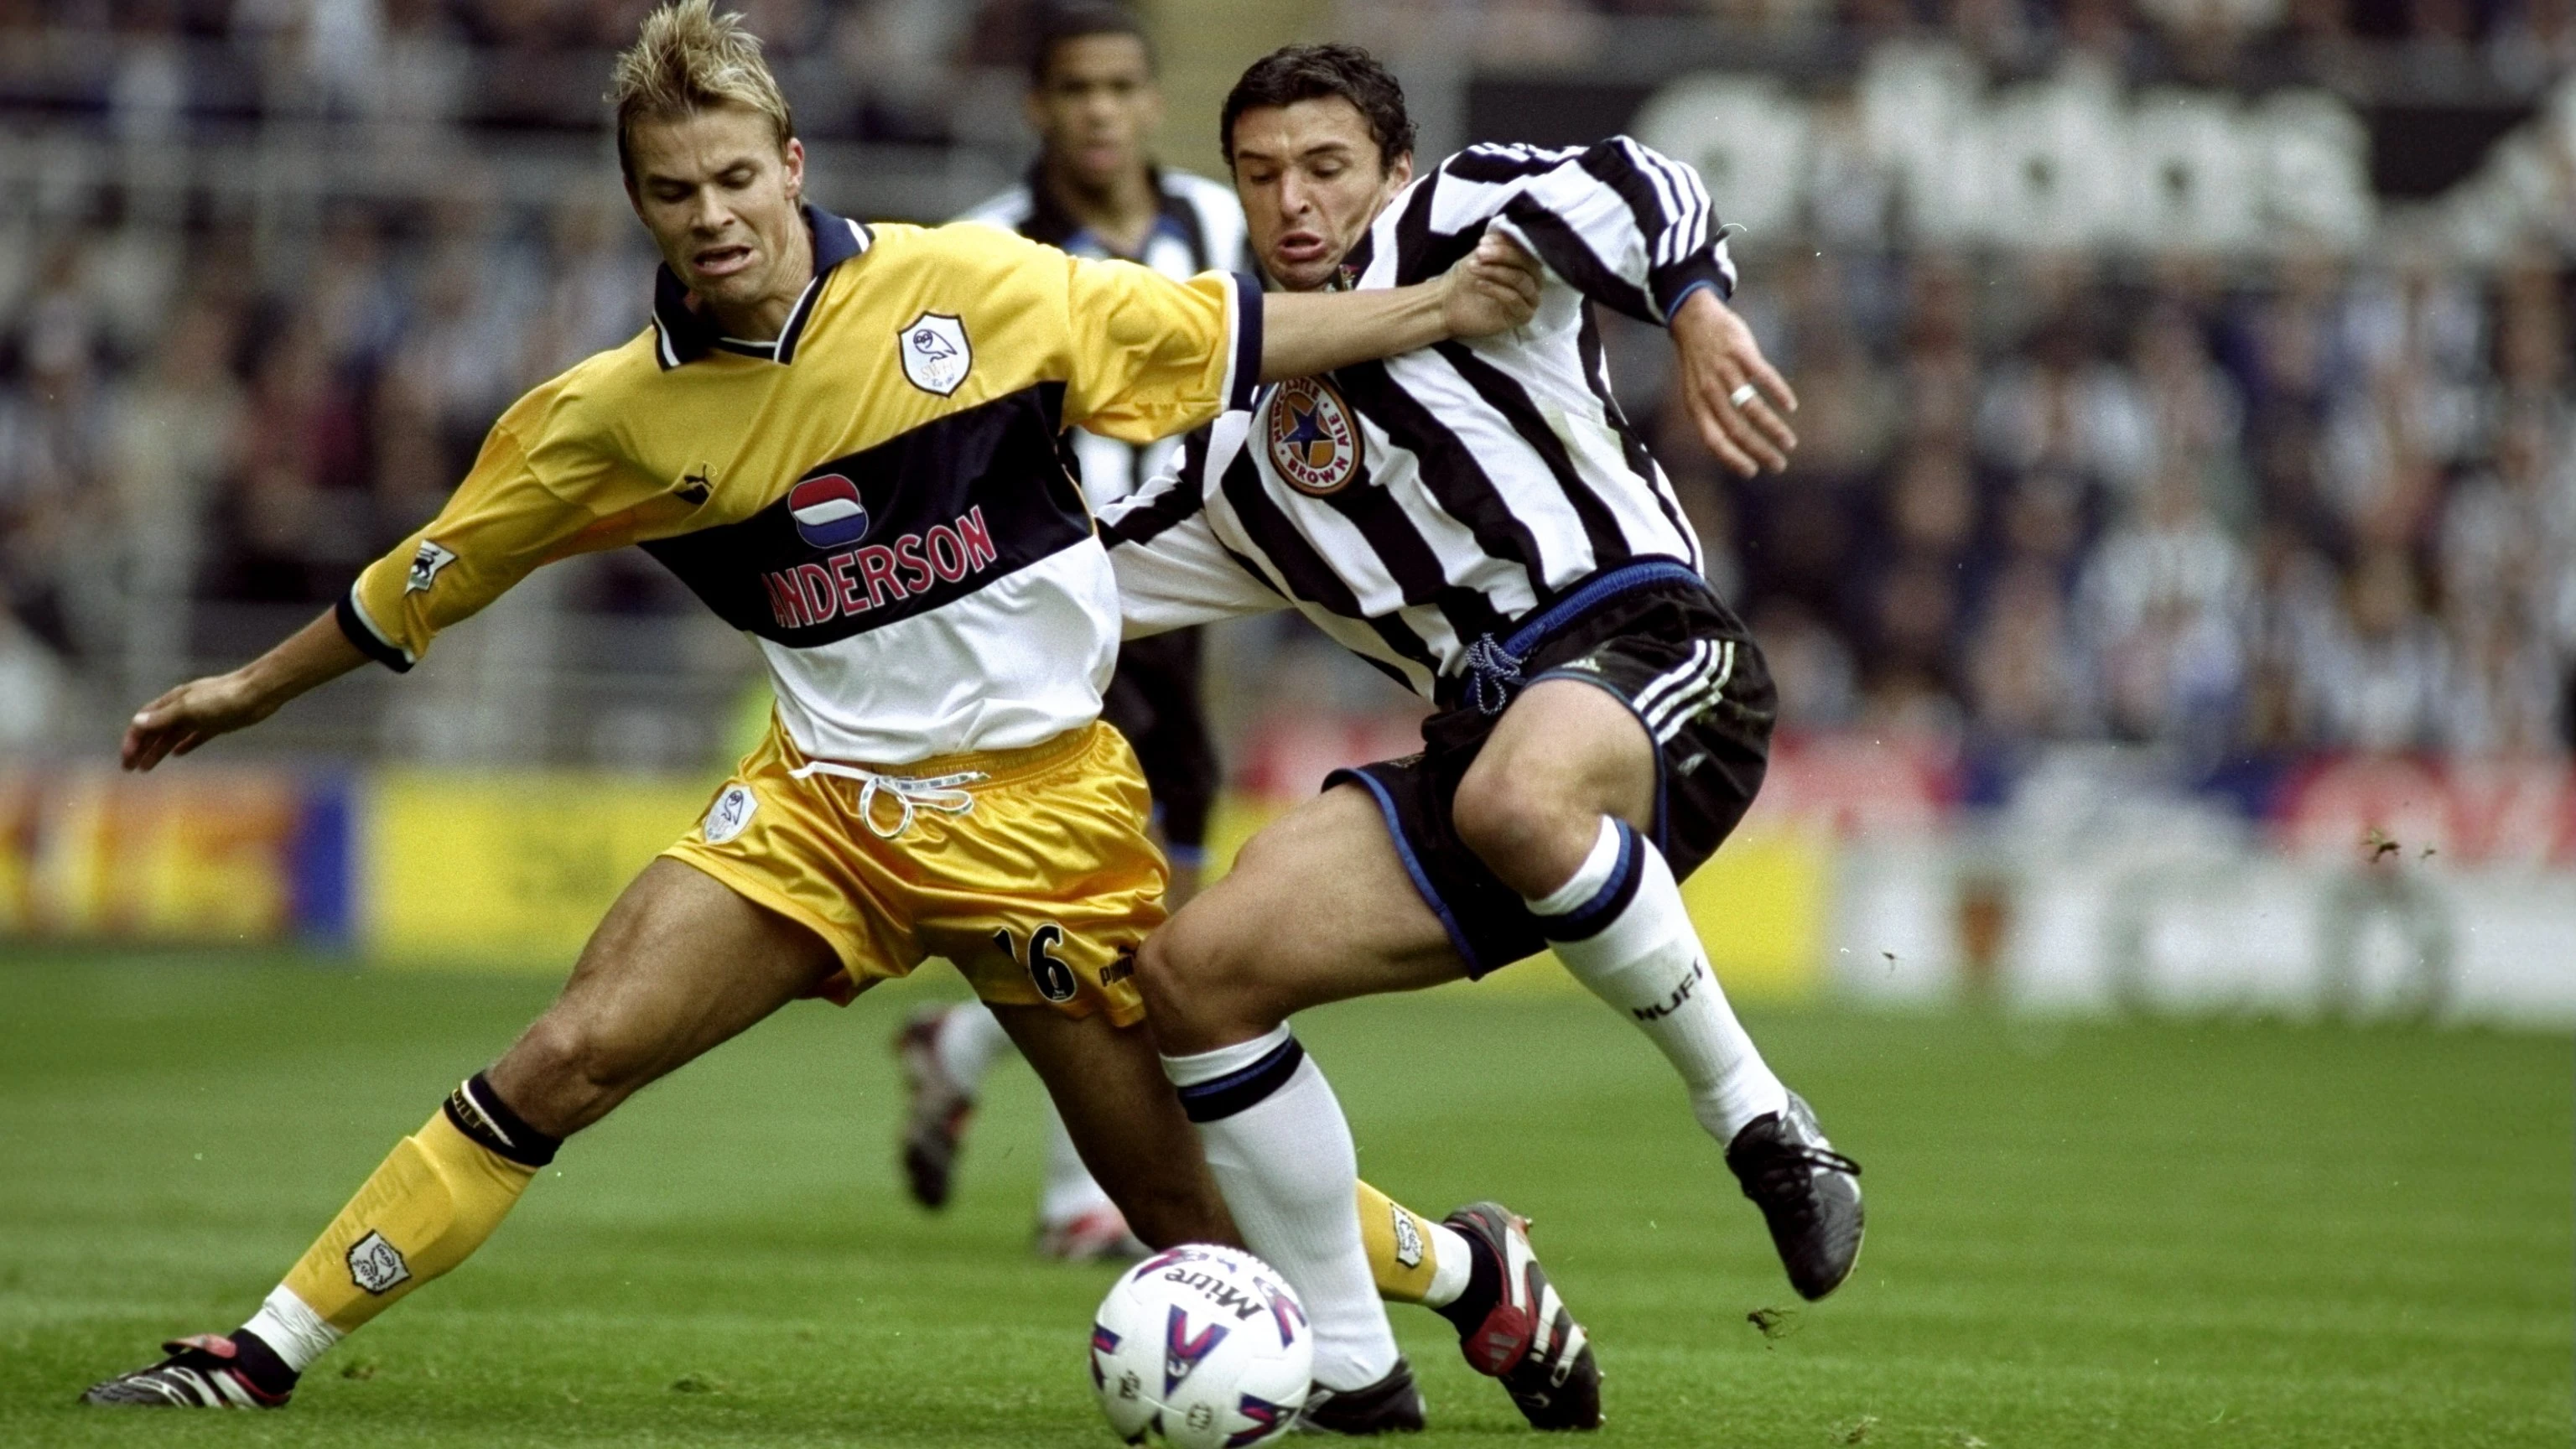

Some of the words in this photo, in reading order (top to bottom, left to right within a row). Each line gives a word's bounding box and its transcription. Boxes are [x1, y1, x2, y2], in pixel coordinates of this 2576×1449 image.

[1287, 456, 1349, 484] BROWN
[1328, 412, 1350, 448] ALE
[761, 505, 997, 629] ANDERSON
[1164, 1267, 1265, 1322] Mitre
